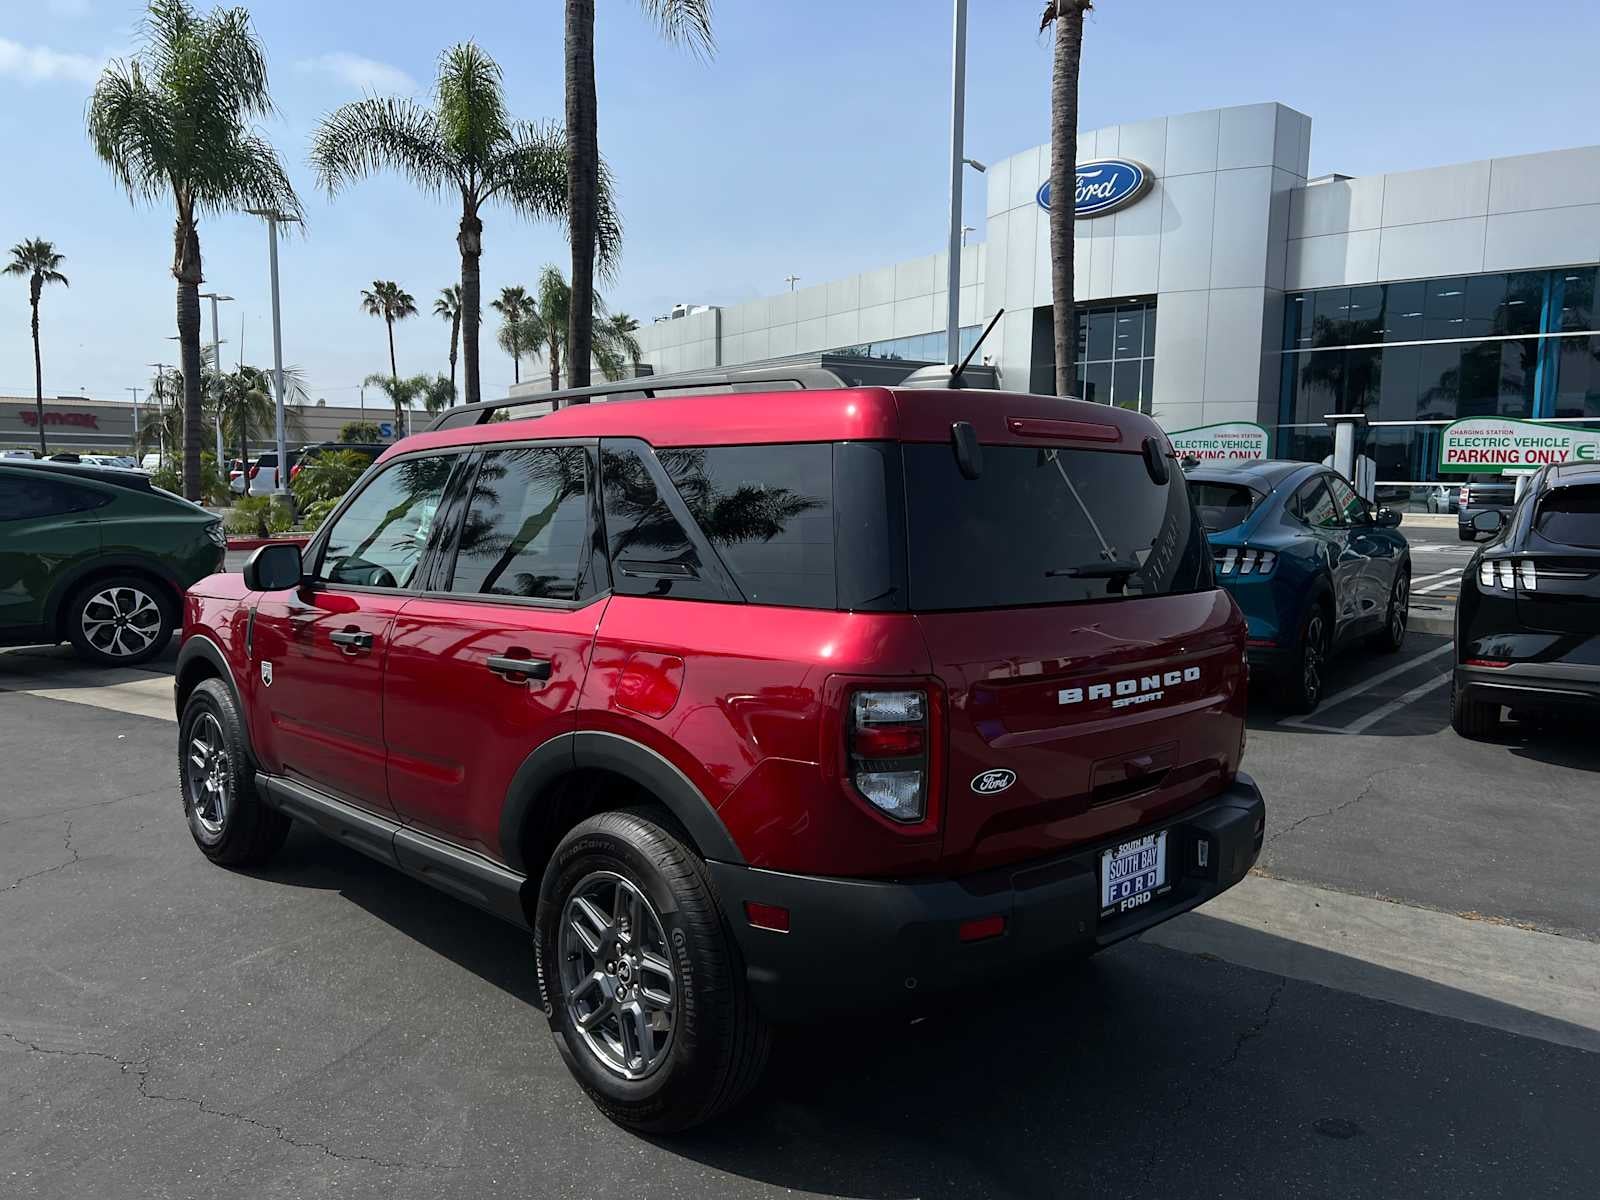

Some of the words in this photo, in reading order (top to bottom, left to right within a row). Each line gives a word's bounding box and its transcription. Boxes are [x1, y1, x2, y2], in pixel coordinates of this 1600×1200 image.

[1174, 440, 1220, 449] ELECTRIC
[1220, 440, 1262, 449] VEHICLE
[1449, 437, 1511, 448] ELECTRIC
[1514, 437, 1570, 448] VEHICLE
[1174, 450, 1225, 459] PARKING
[1228, 450, 1262, 460] ONLY
[1447, 449, 1520, 463] PARKING
[1524, 449, 1570, 464] ONLY
[1058, 666, 1201, 705] BRONCO
[1112, 691, 1165, 708] SPORT
[979, 772, 1010, 791] Ford
[1119, 840, 1141, 854] SOUTH
[1142, 834, 1156, 847] BAY
[1110, 854, 1139, 879] SOUTH
[1141, 847, 1158, 870] BAY
[1110, 872, 1156, 903] FORD
[1121, 891, 1152, 912] FORD
